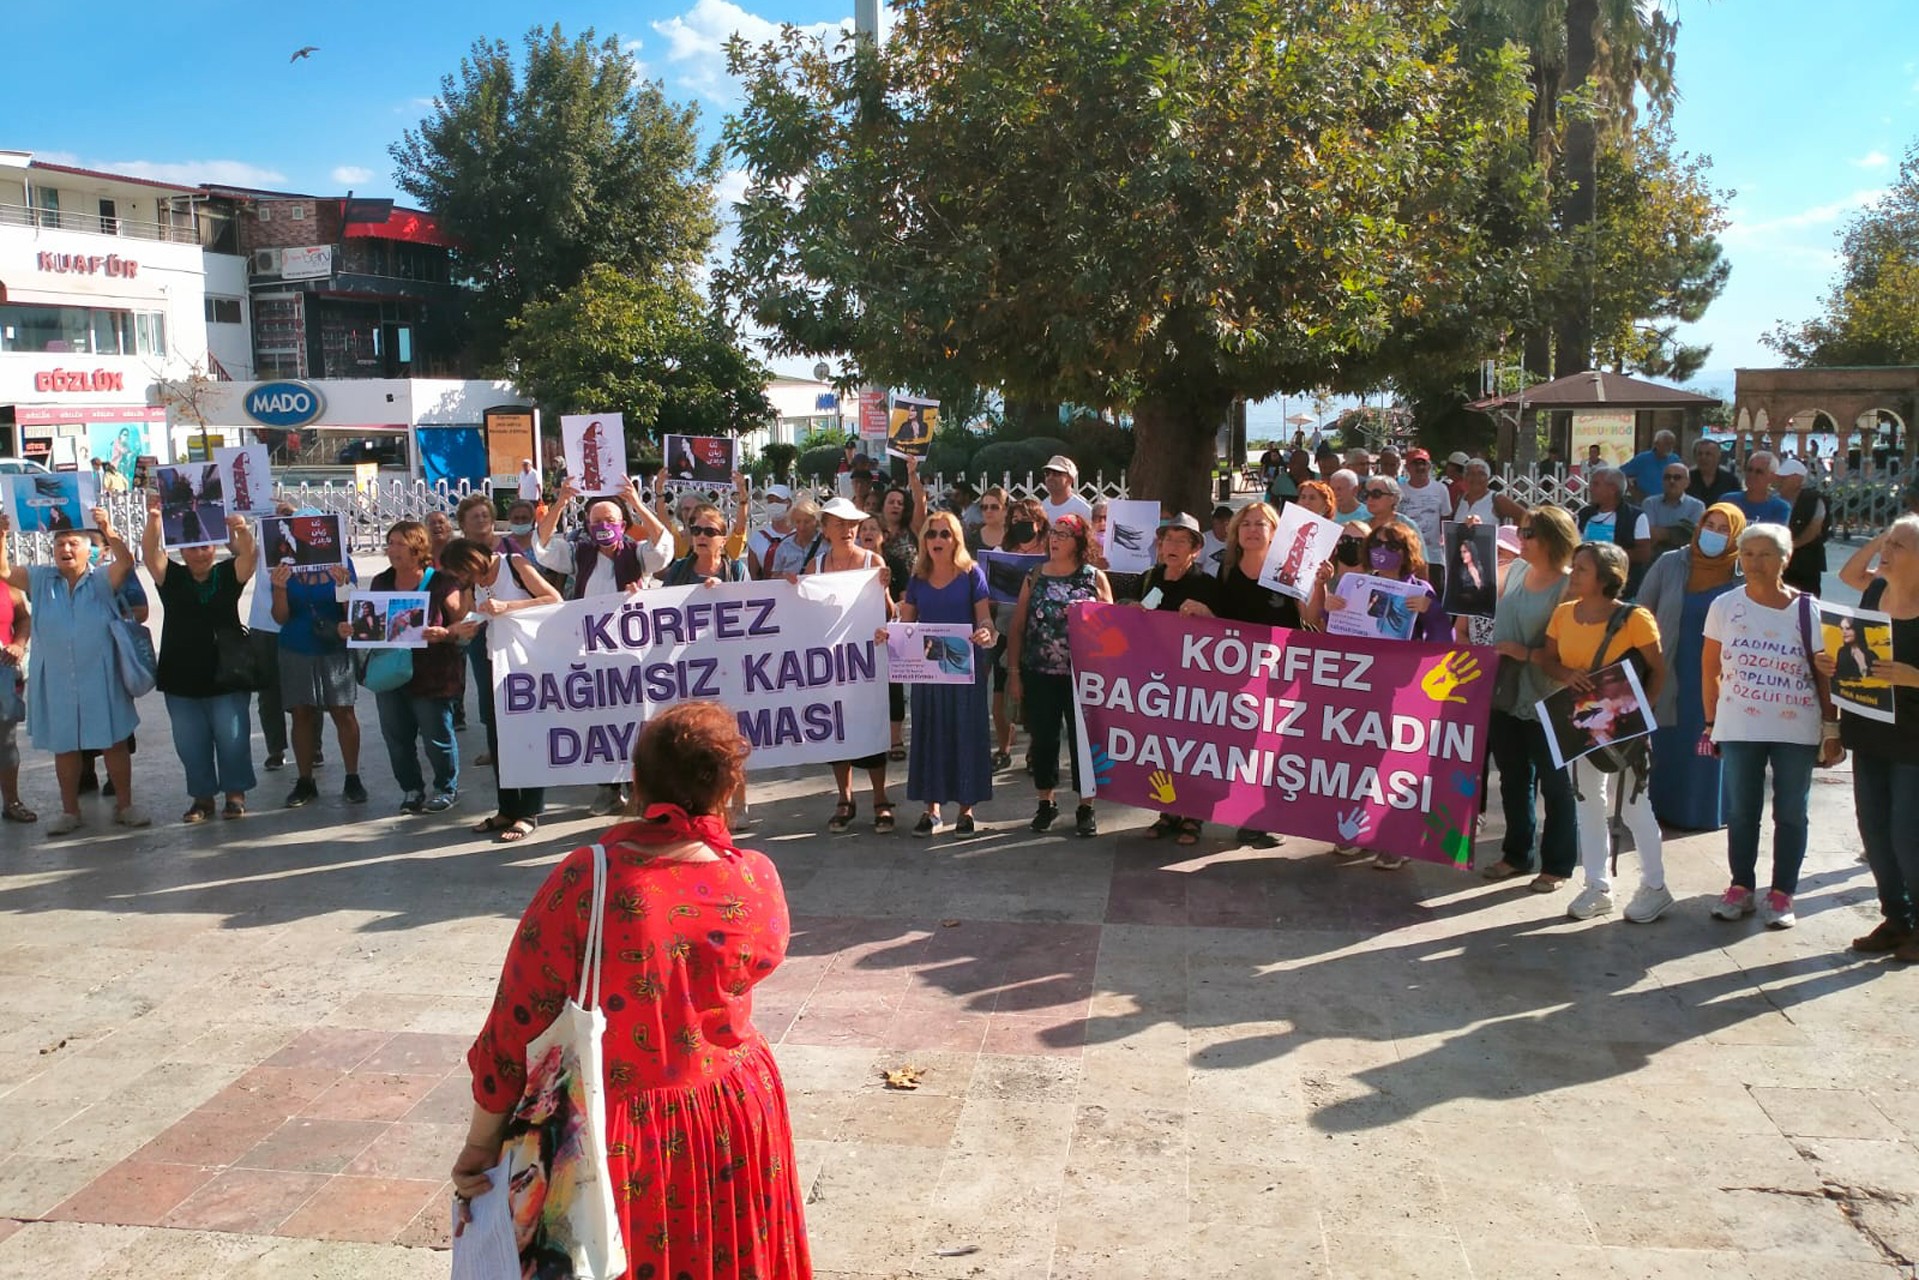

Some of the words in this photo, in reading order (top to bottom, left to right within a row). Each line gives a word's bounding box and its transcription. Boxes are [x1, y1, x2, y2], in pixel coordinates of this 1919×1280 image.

[253, 392, 310, 413] MADO
[583, 598, 781, 654] KÖRFEZ
[1181, 628, 1375, 692] KÖRFEZ
[505, 658, 721, 713] BAĞIMSIZ
[743, 640, 877, 694] KADIN
[1078, 671, 1308, 738] BAĞIMSIZ
[1321, 704, 1475, 763] KADIN
[1107, 727, 1433, 813] DAYANIŞMASI
